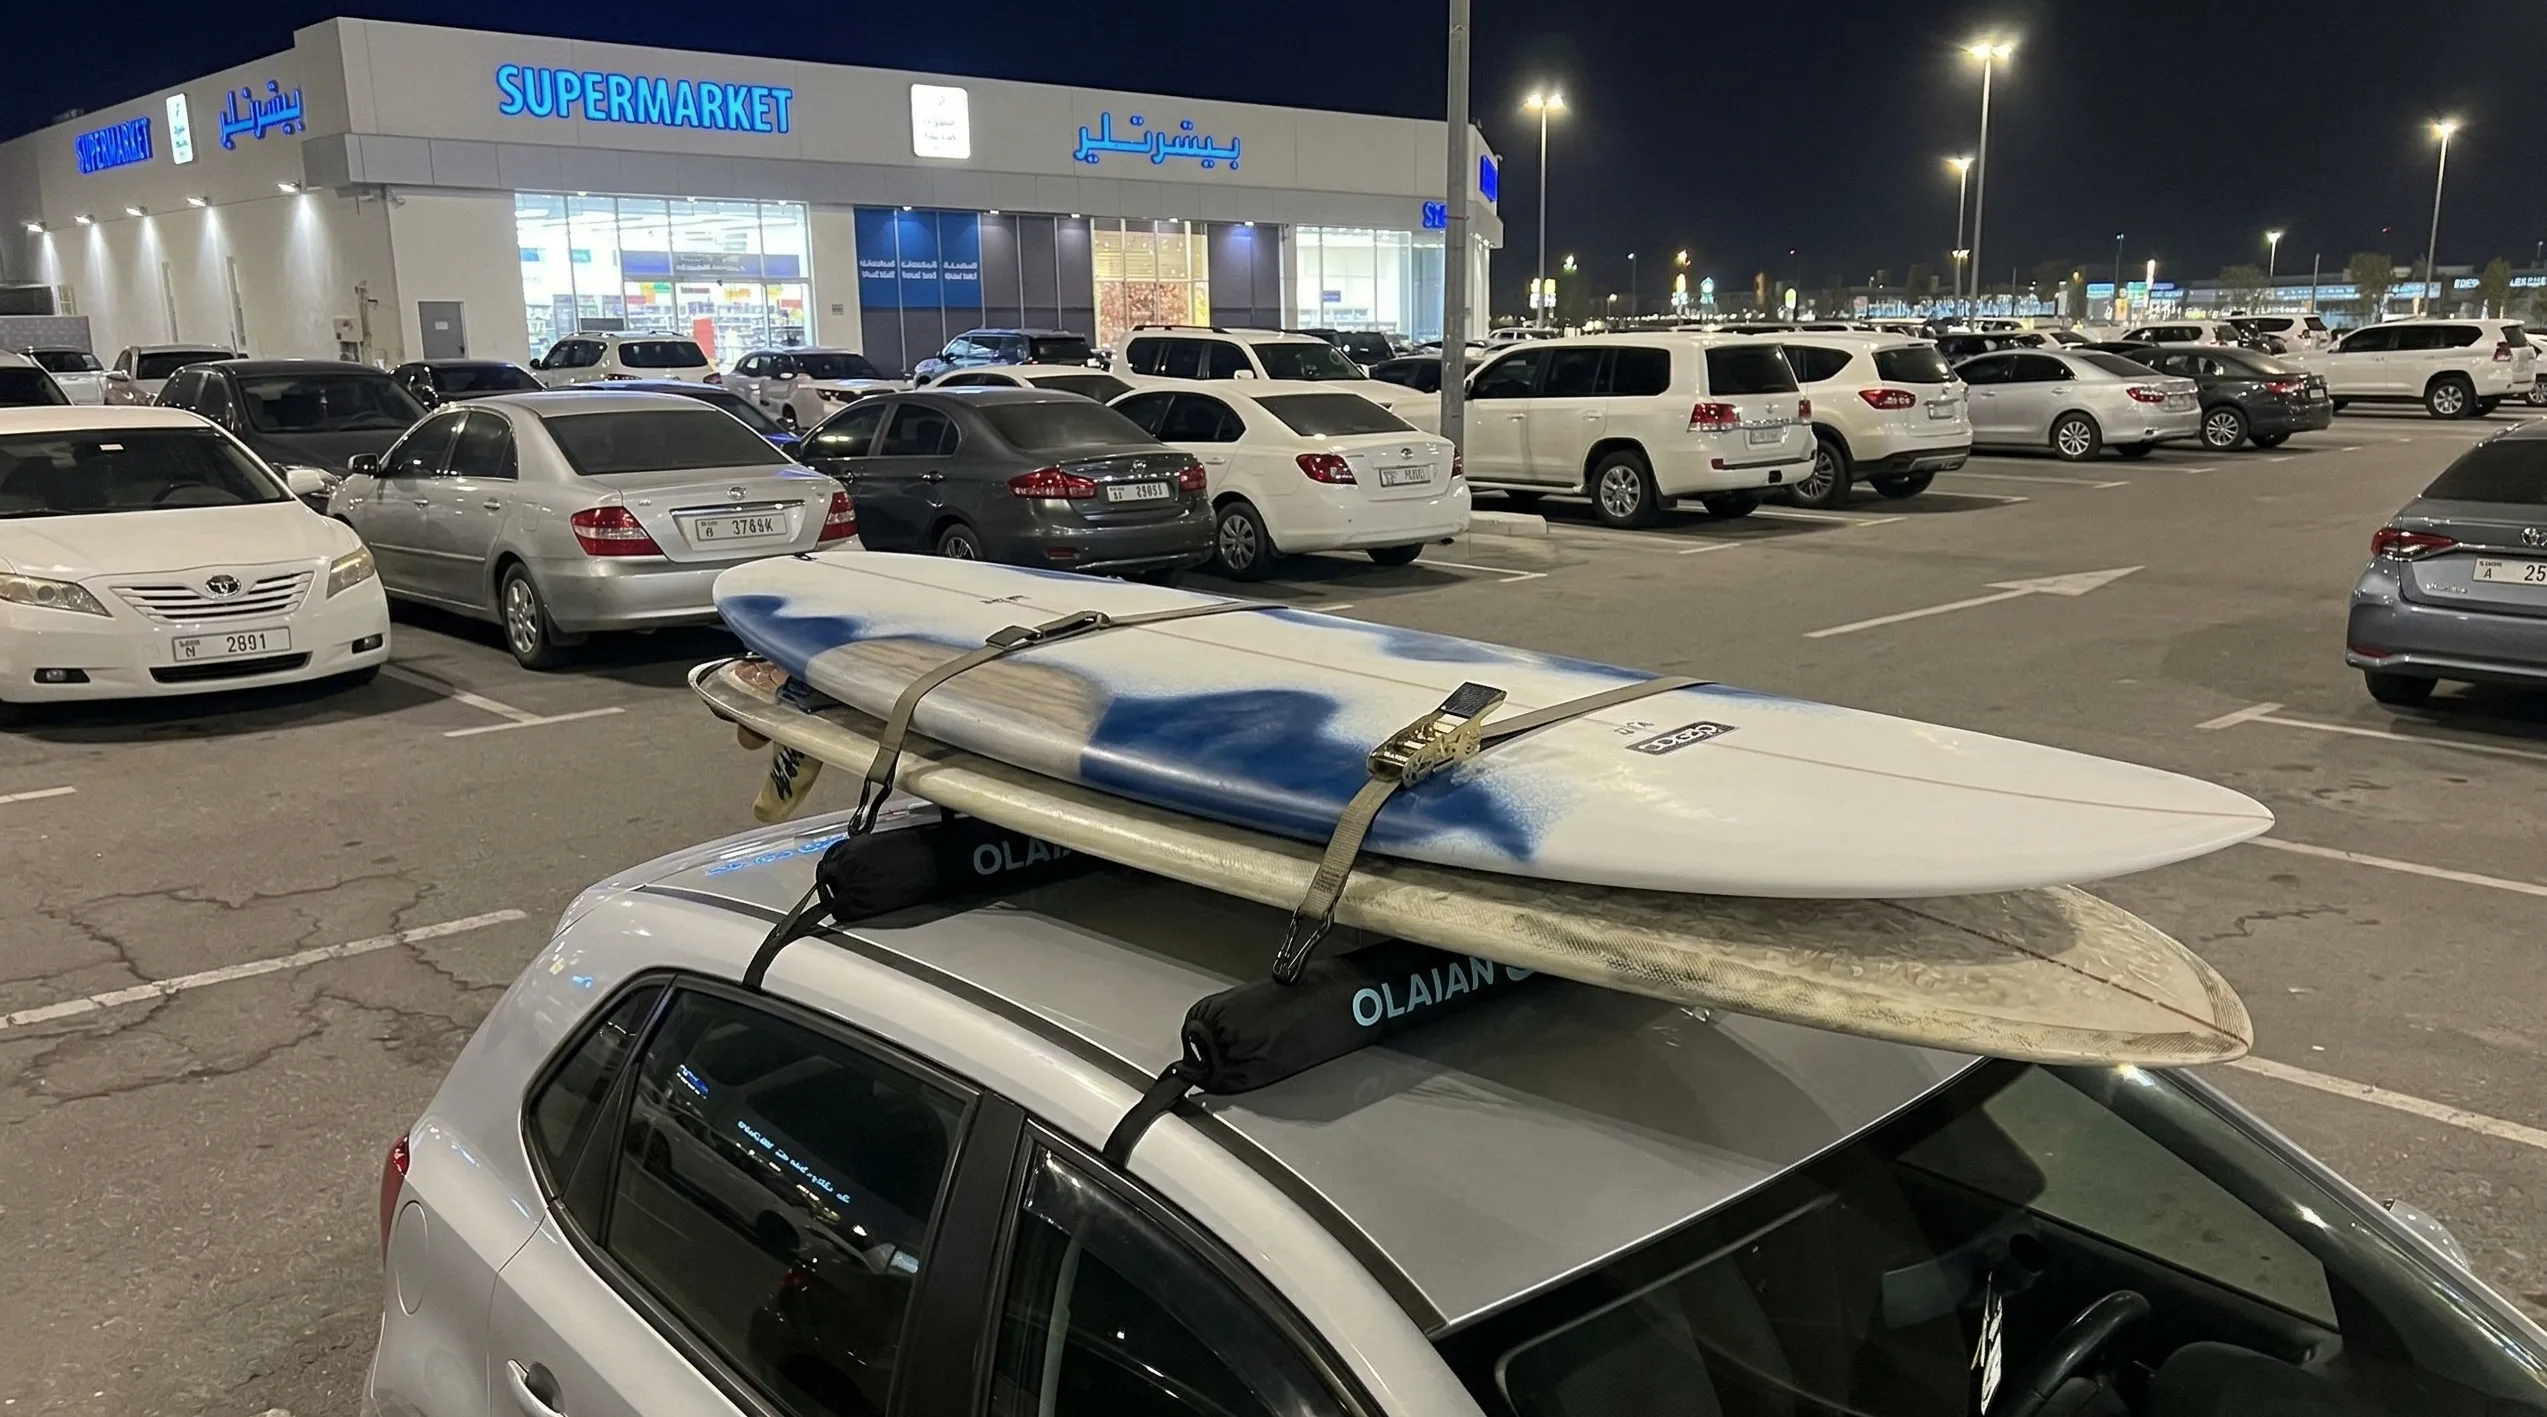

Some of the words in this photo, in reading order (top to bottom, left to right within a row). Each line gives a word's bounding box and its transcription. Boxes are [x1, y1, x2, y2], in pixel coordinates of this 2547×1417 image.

[496, 64, 793, 134] SUPERMARKET
[75, 116, 153, 174] SUPERMARKET
[2483, 568, 2492, 579] A
[1352, 956, 1494, 1027] OLAIAN
